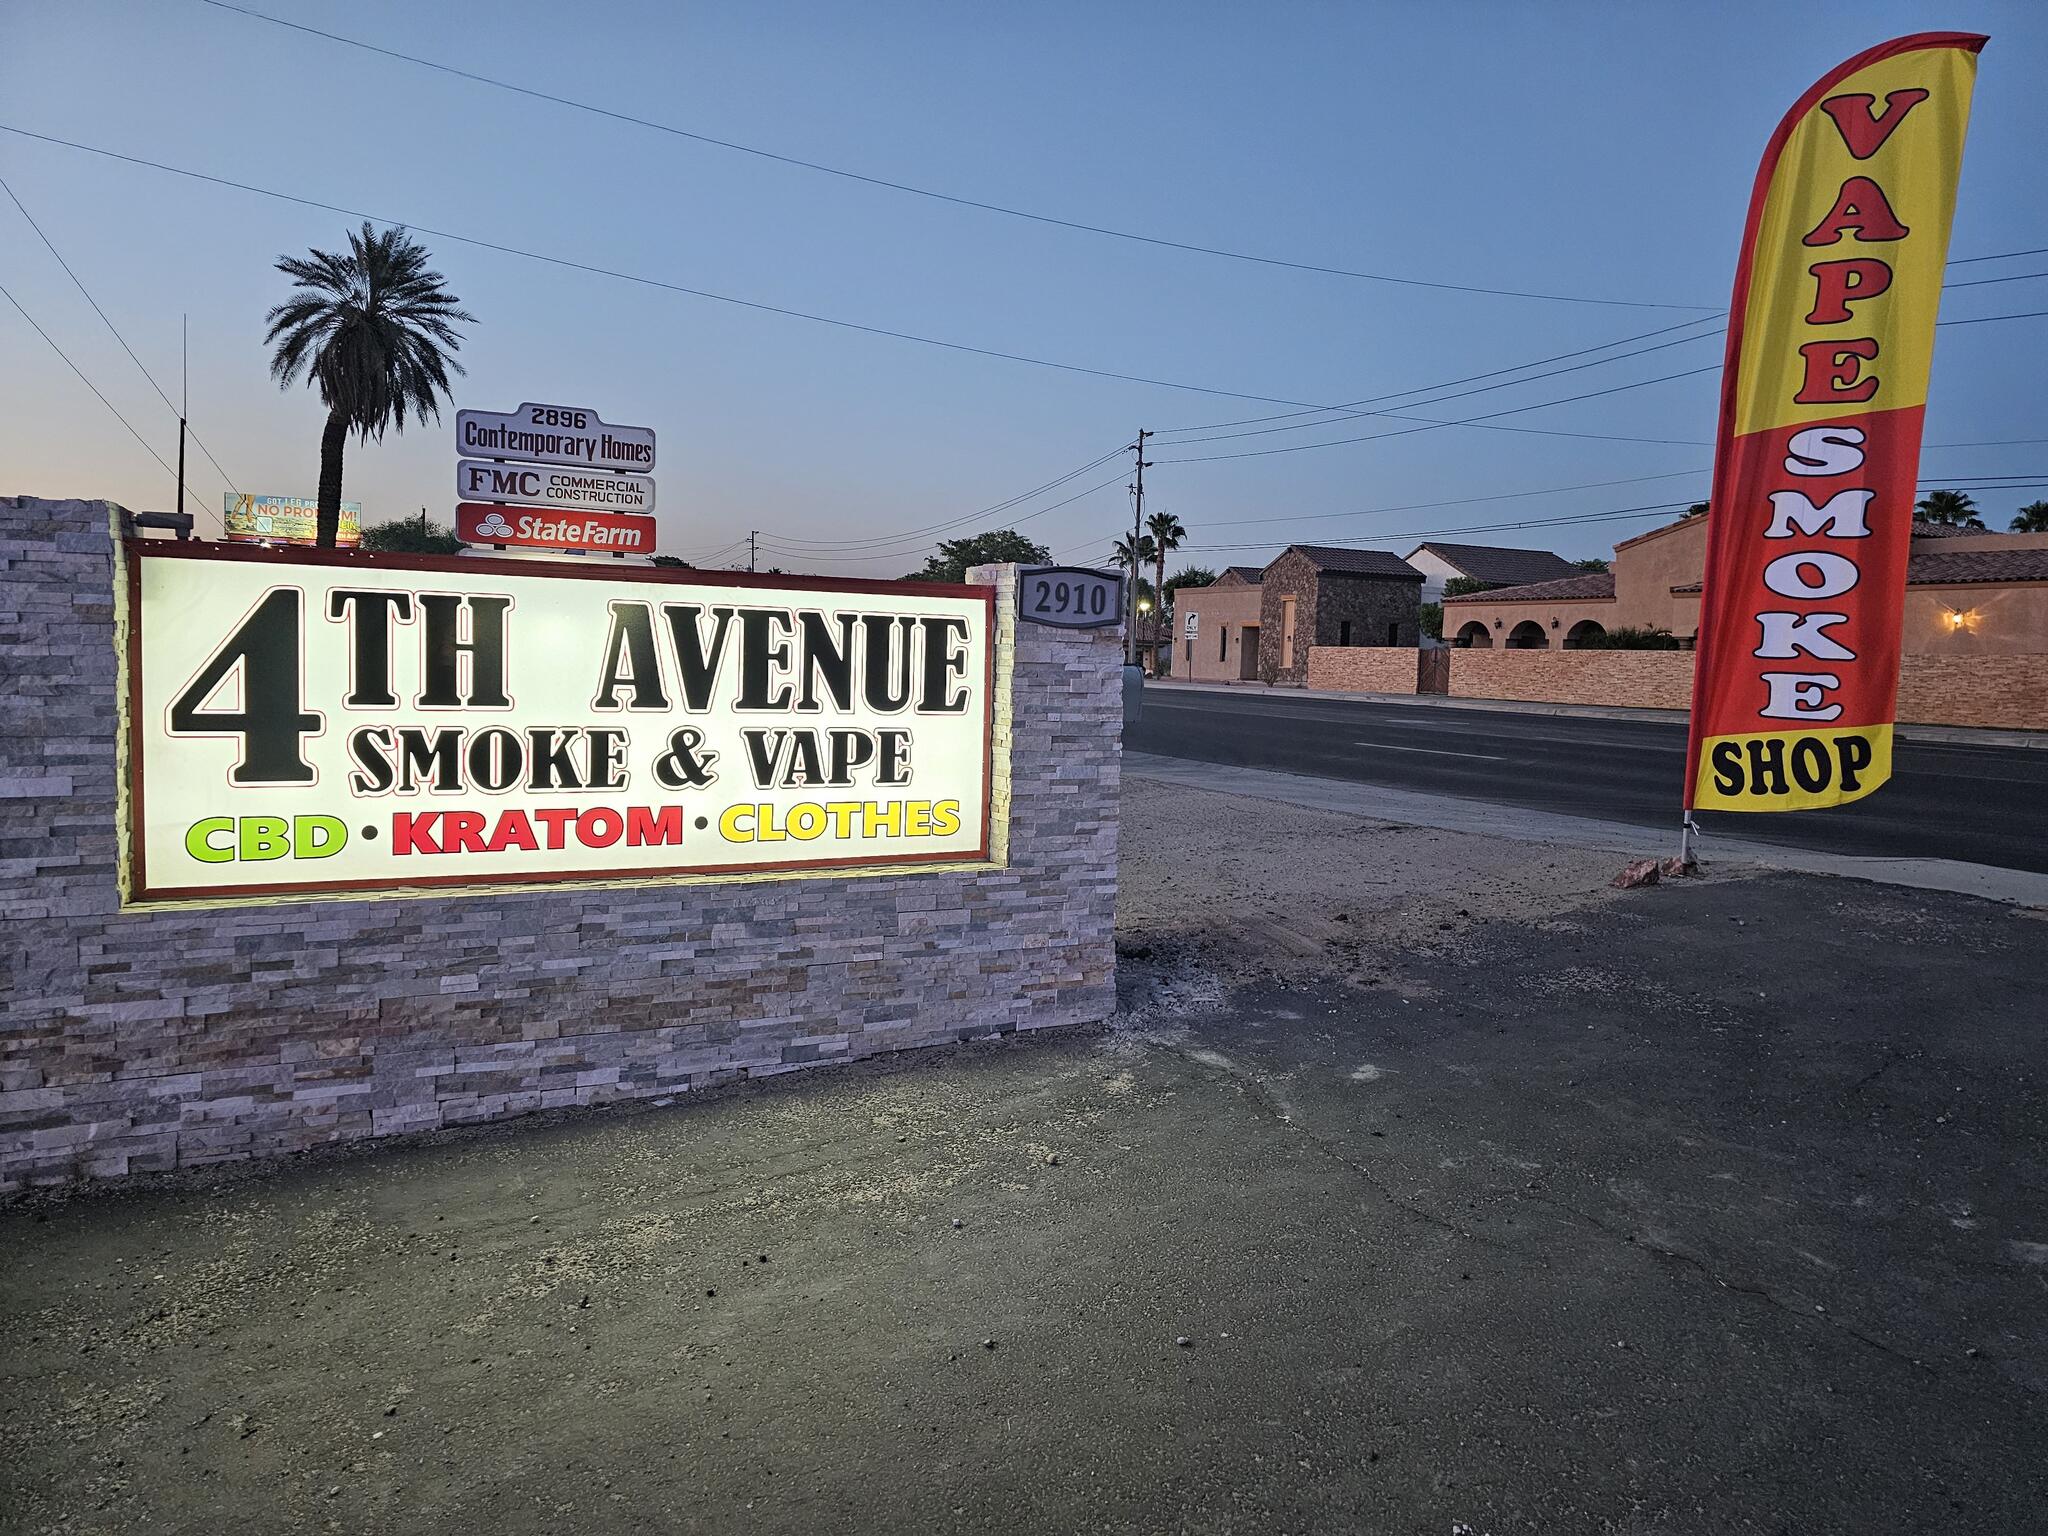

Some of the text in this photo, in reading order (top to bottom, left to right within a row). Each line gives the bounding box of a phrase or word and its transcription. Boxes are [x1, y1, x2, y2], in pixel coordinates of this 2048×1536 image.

[1794, 88, 1930, 405] VAPE
[531, 408, 587, 430] 2896
[465, 421, 652, 463] Contemporary Homes
[468, 467, 541, 497] FMC
[546, 487, 643, 505] CONSTRUCTION
[550, 475, 645, 494] COMMERCIAL
[257, 504, 280, 516] NO
[1753, 426, 1877, 722] SMOKE
[1035, 580, 1106, 615] 2910
[596, 600, 968, 711] AVENUE
[353, 727, 911, 792] SMOKE & VAPE
[1711, 735, 1872, 797] SHOP
[185, 800, 961, 863] CBD KRATOM CLOTHES
